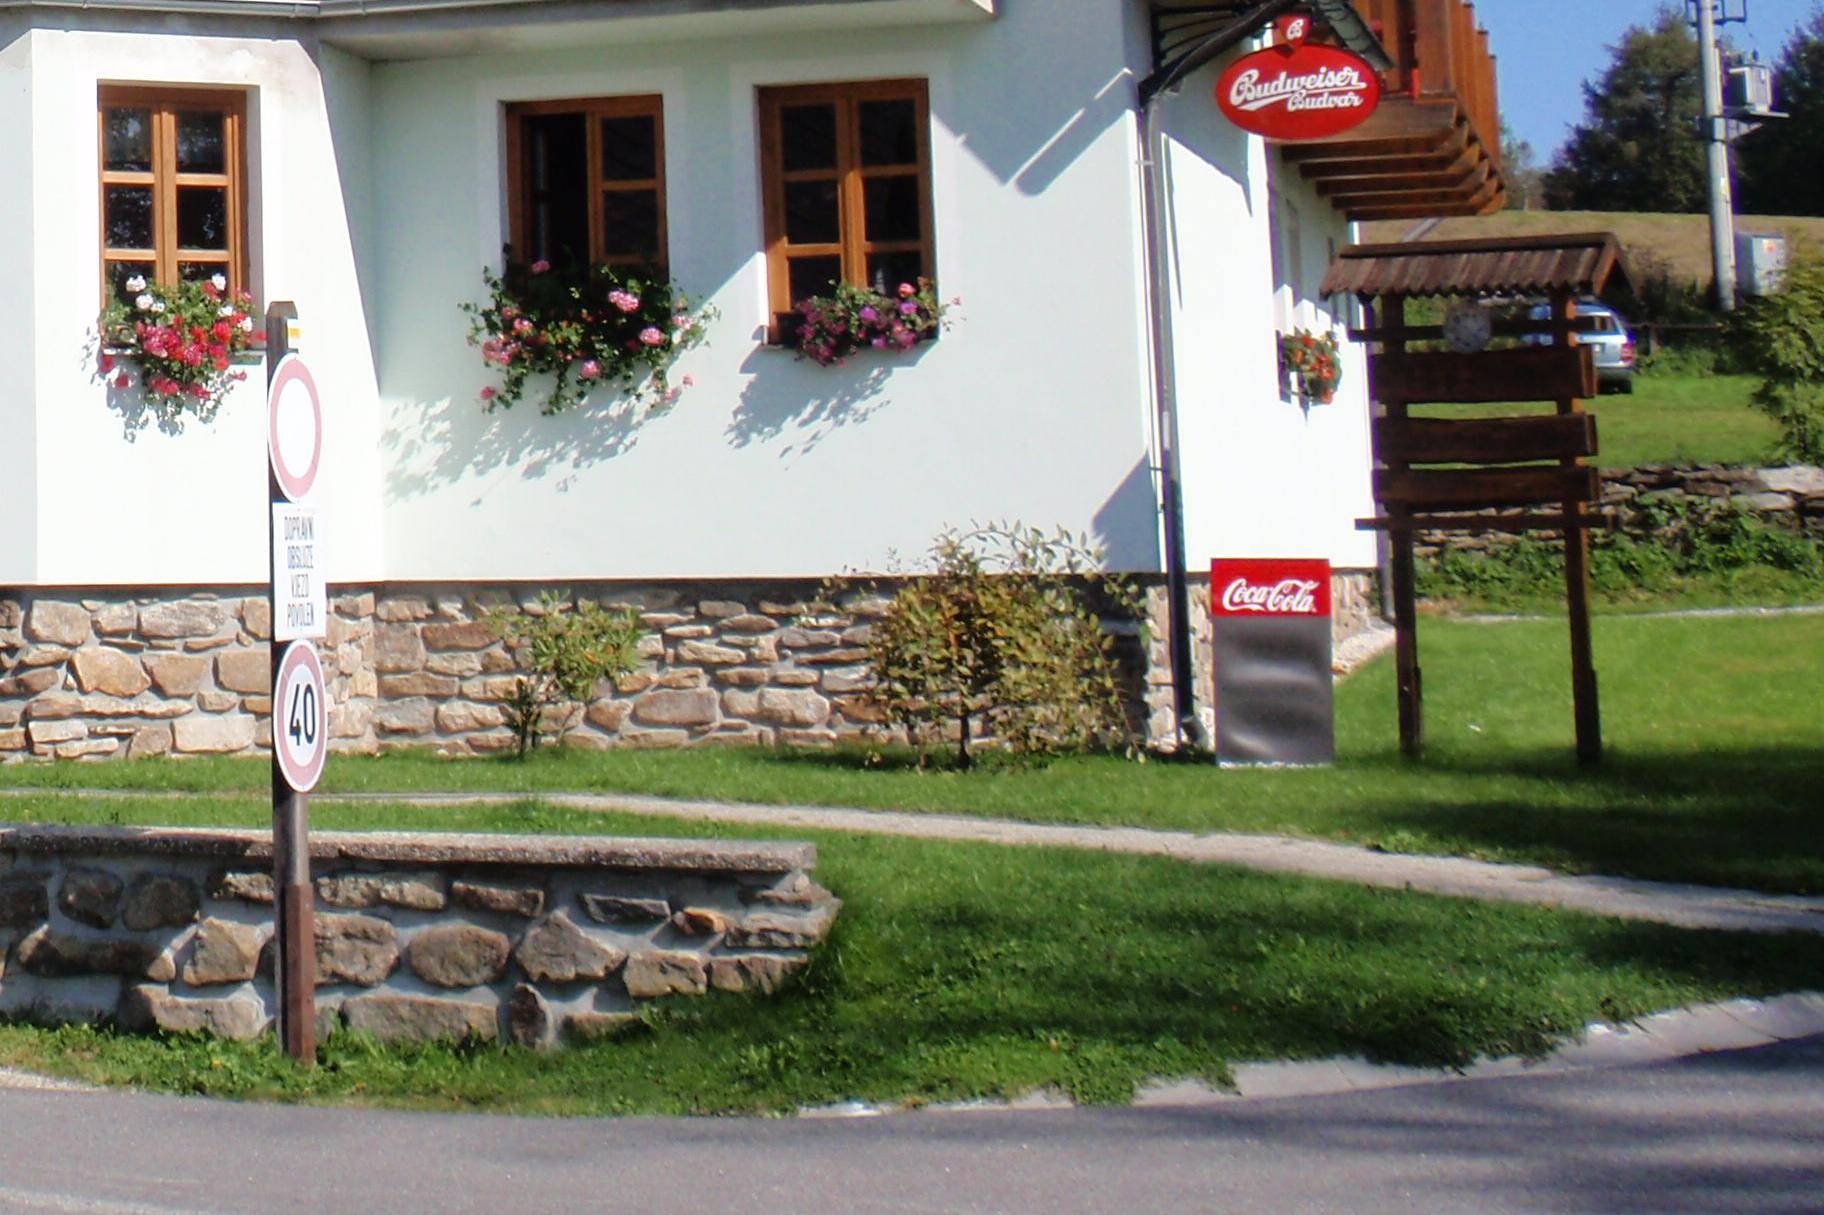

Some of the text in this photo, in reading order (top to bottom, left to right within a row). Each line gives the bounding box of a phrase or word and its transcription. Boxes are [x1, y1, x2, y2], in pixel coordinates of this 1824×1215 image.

[1286, 18, 1304, 40] B
[1230, 66, 1367, 110] Budweiser
[1287, 89, 1364, 112] Budvar
[1222, 578, 1320, 611] Coca-Cola
[289, 683, 315, 746] 40
